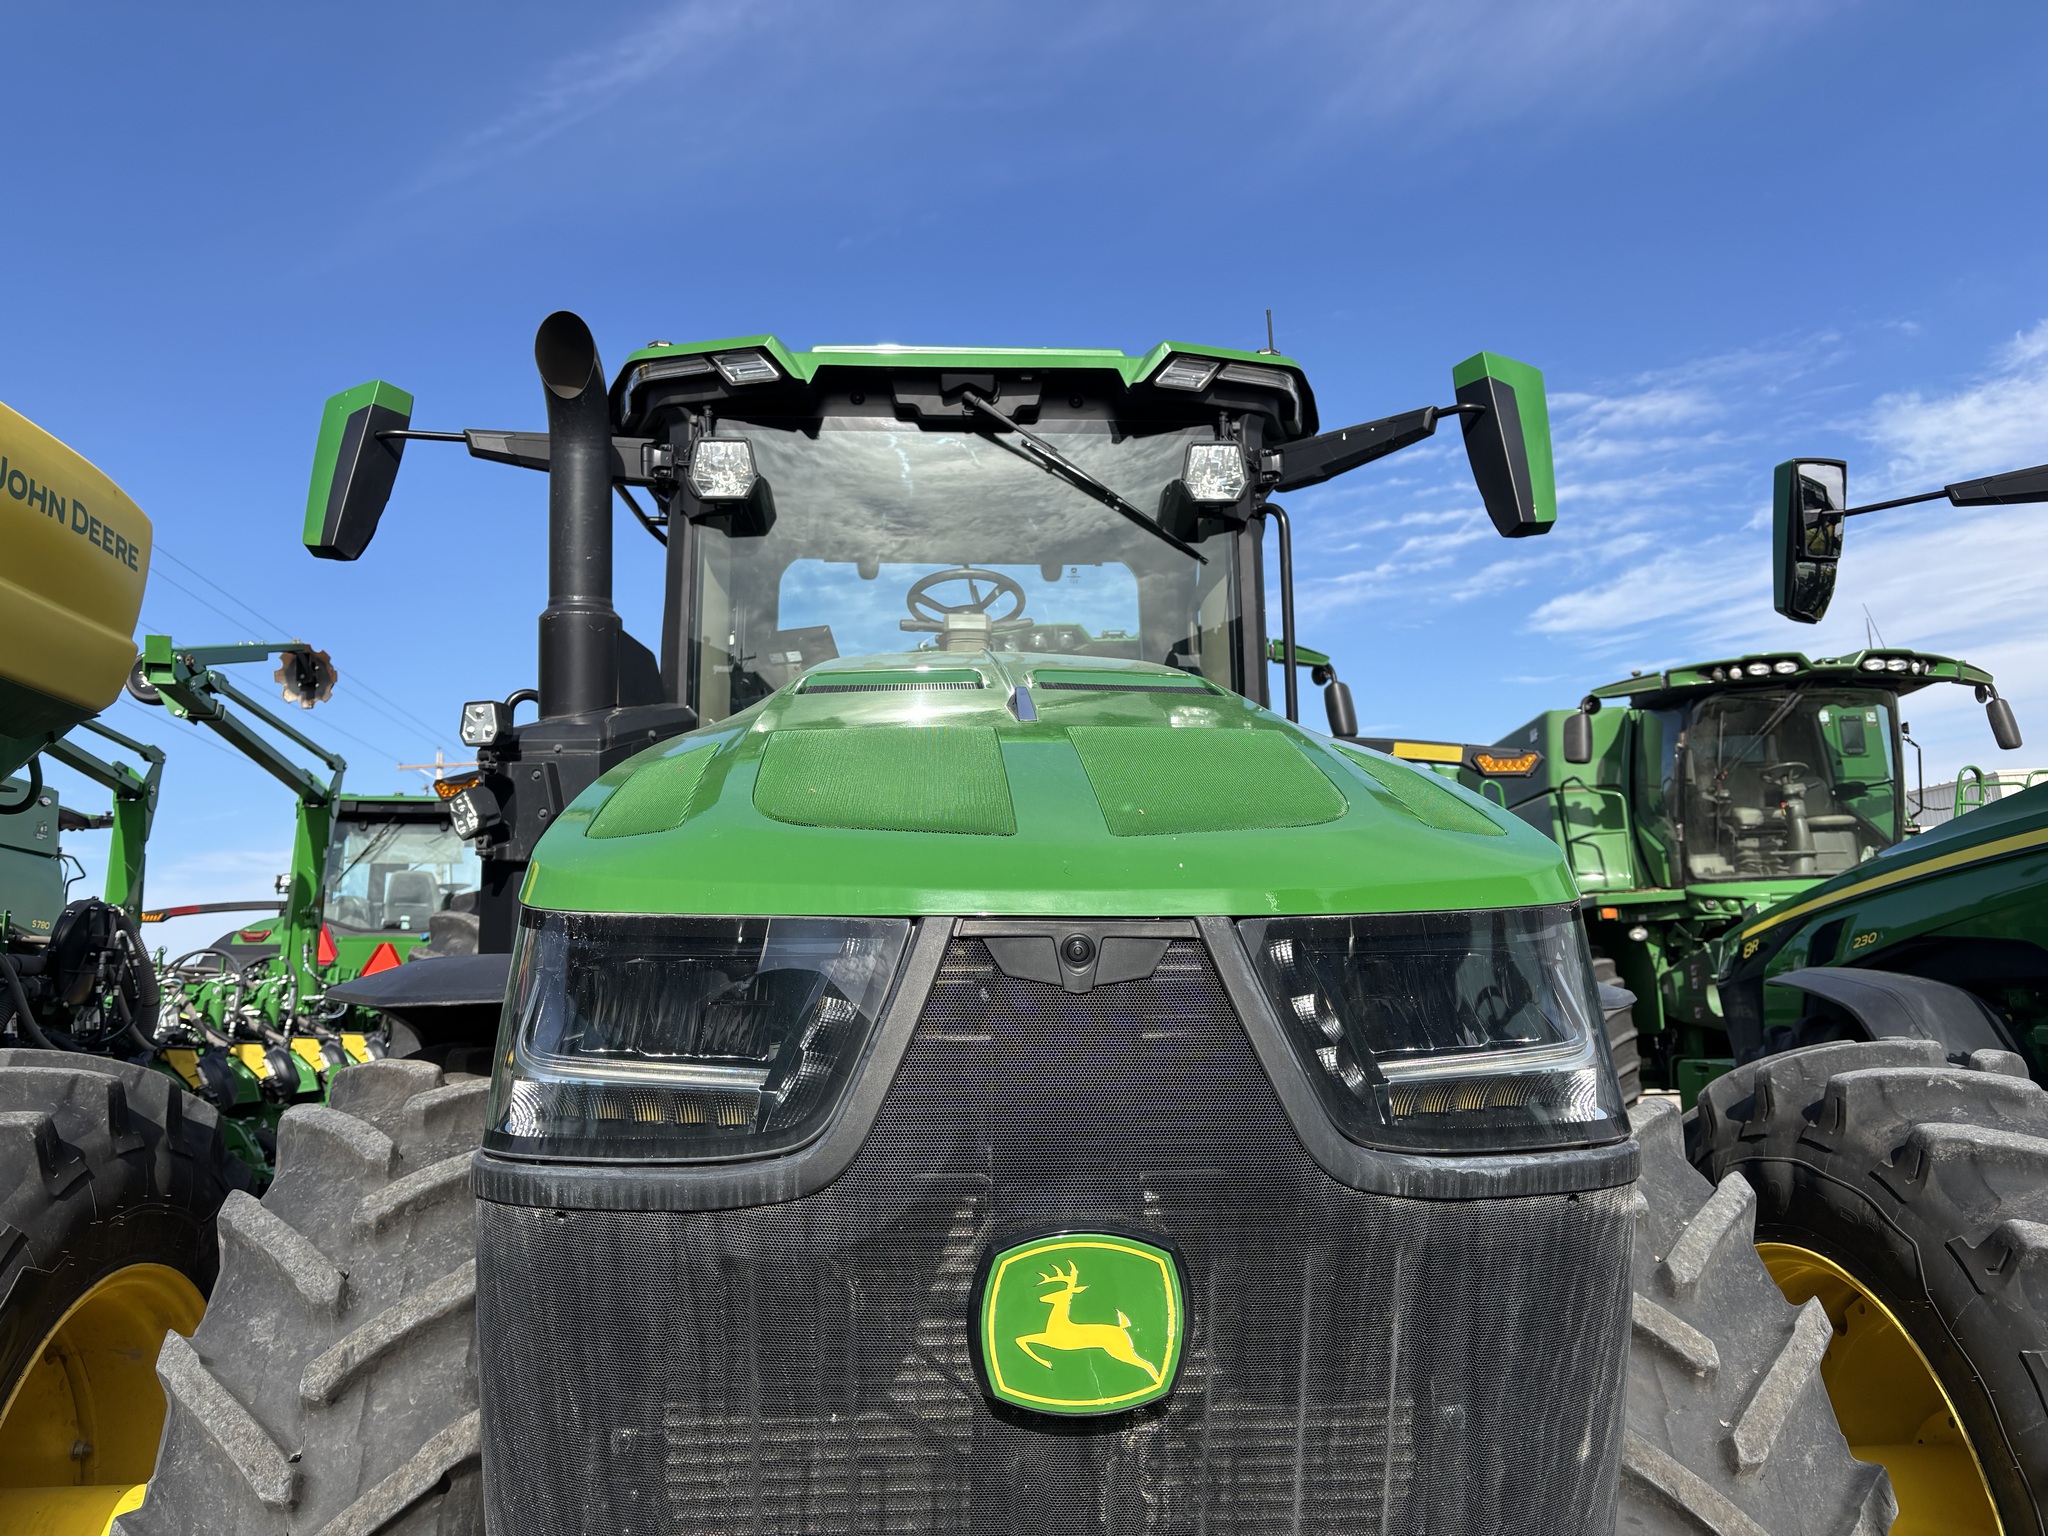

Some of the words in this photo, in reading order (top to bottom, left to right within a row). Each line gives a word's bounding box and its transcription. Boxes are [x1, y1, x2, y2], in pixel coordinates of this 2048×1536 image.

[0, 456, 66, 525] JOHN
[72, 498, 139, 573] DEERE
[31, 919, 51, 930] S780
[1742, 938, 1760, 959] 8R
[1852, 931, 1877, 949] 230
